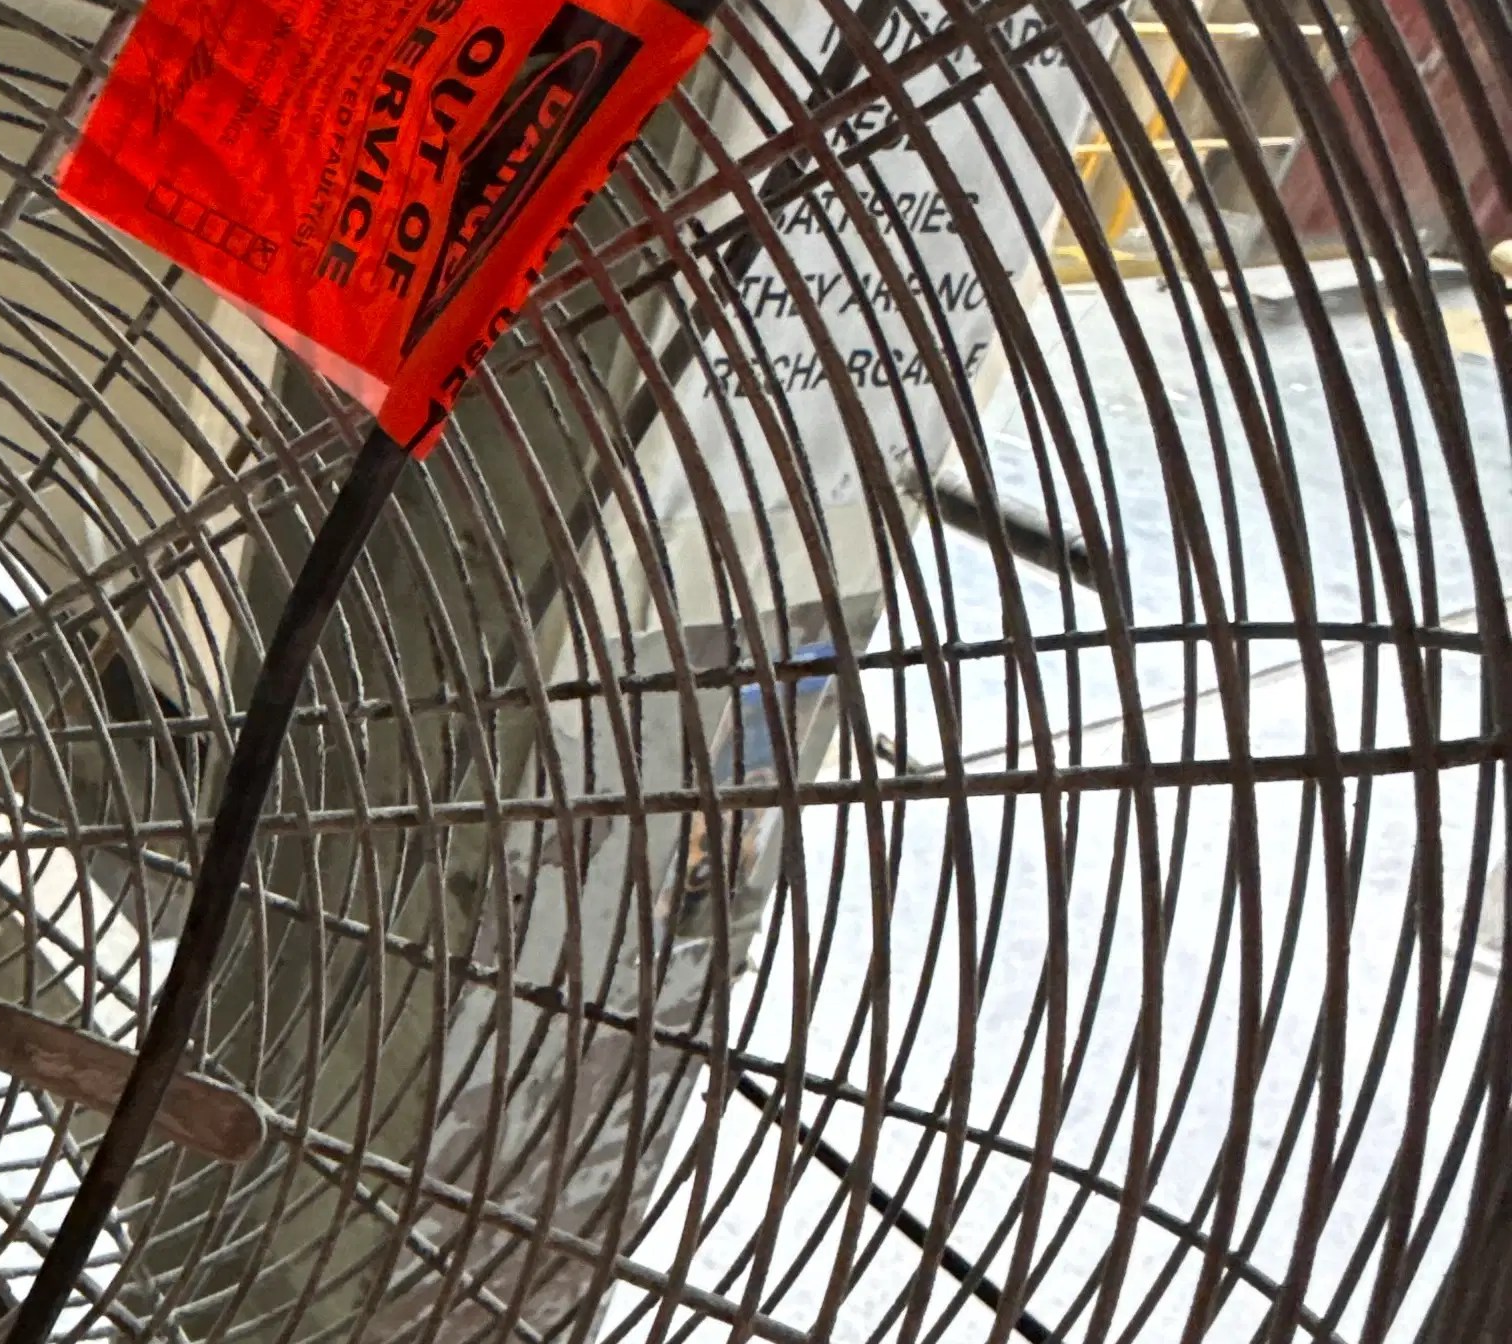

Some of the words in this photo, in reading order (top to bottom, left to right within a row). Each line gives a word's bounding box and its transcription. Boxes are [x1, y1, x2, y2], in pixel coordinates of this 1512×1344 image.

[415, 26, 503, 185] OUT
[289, 135, 346, 250] FAULT(S)
[436, 83, 576, 298] DANGE
[776, 192, 980, 234] ATERIES
[383, 203, 430, 299] OF
[938, 270, 1014, 313] NO
[703, 342, 988, 398] RCHARGAE
